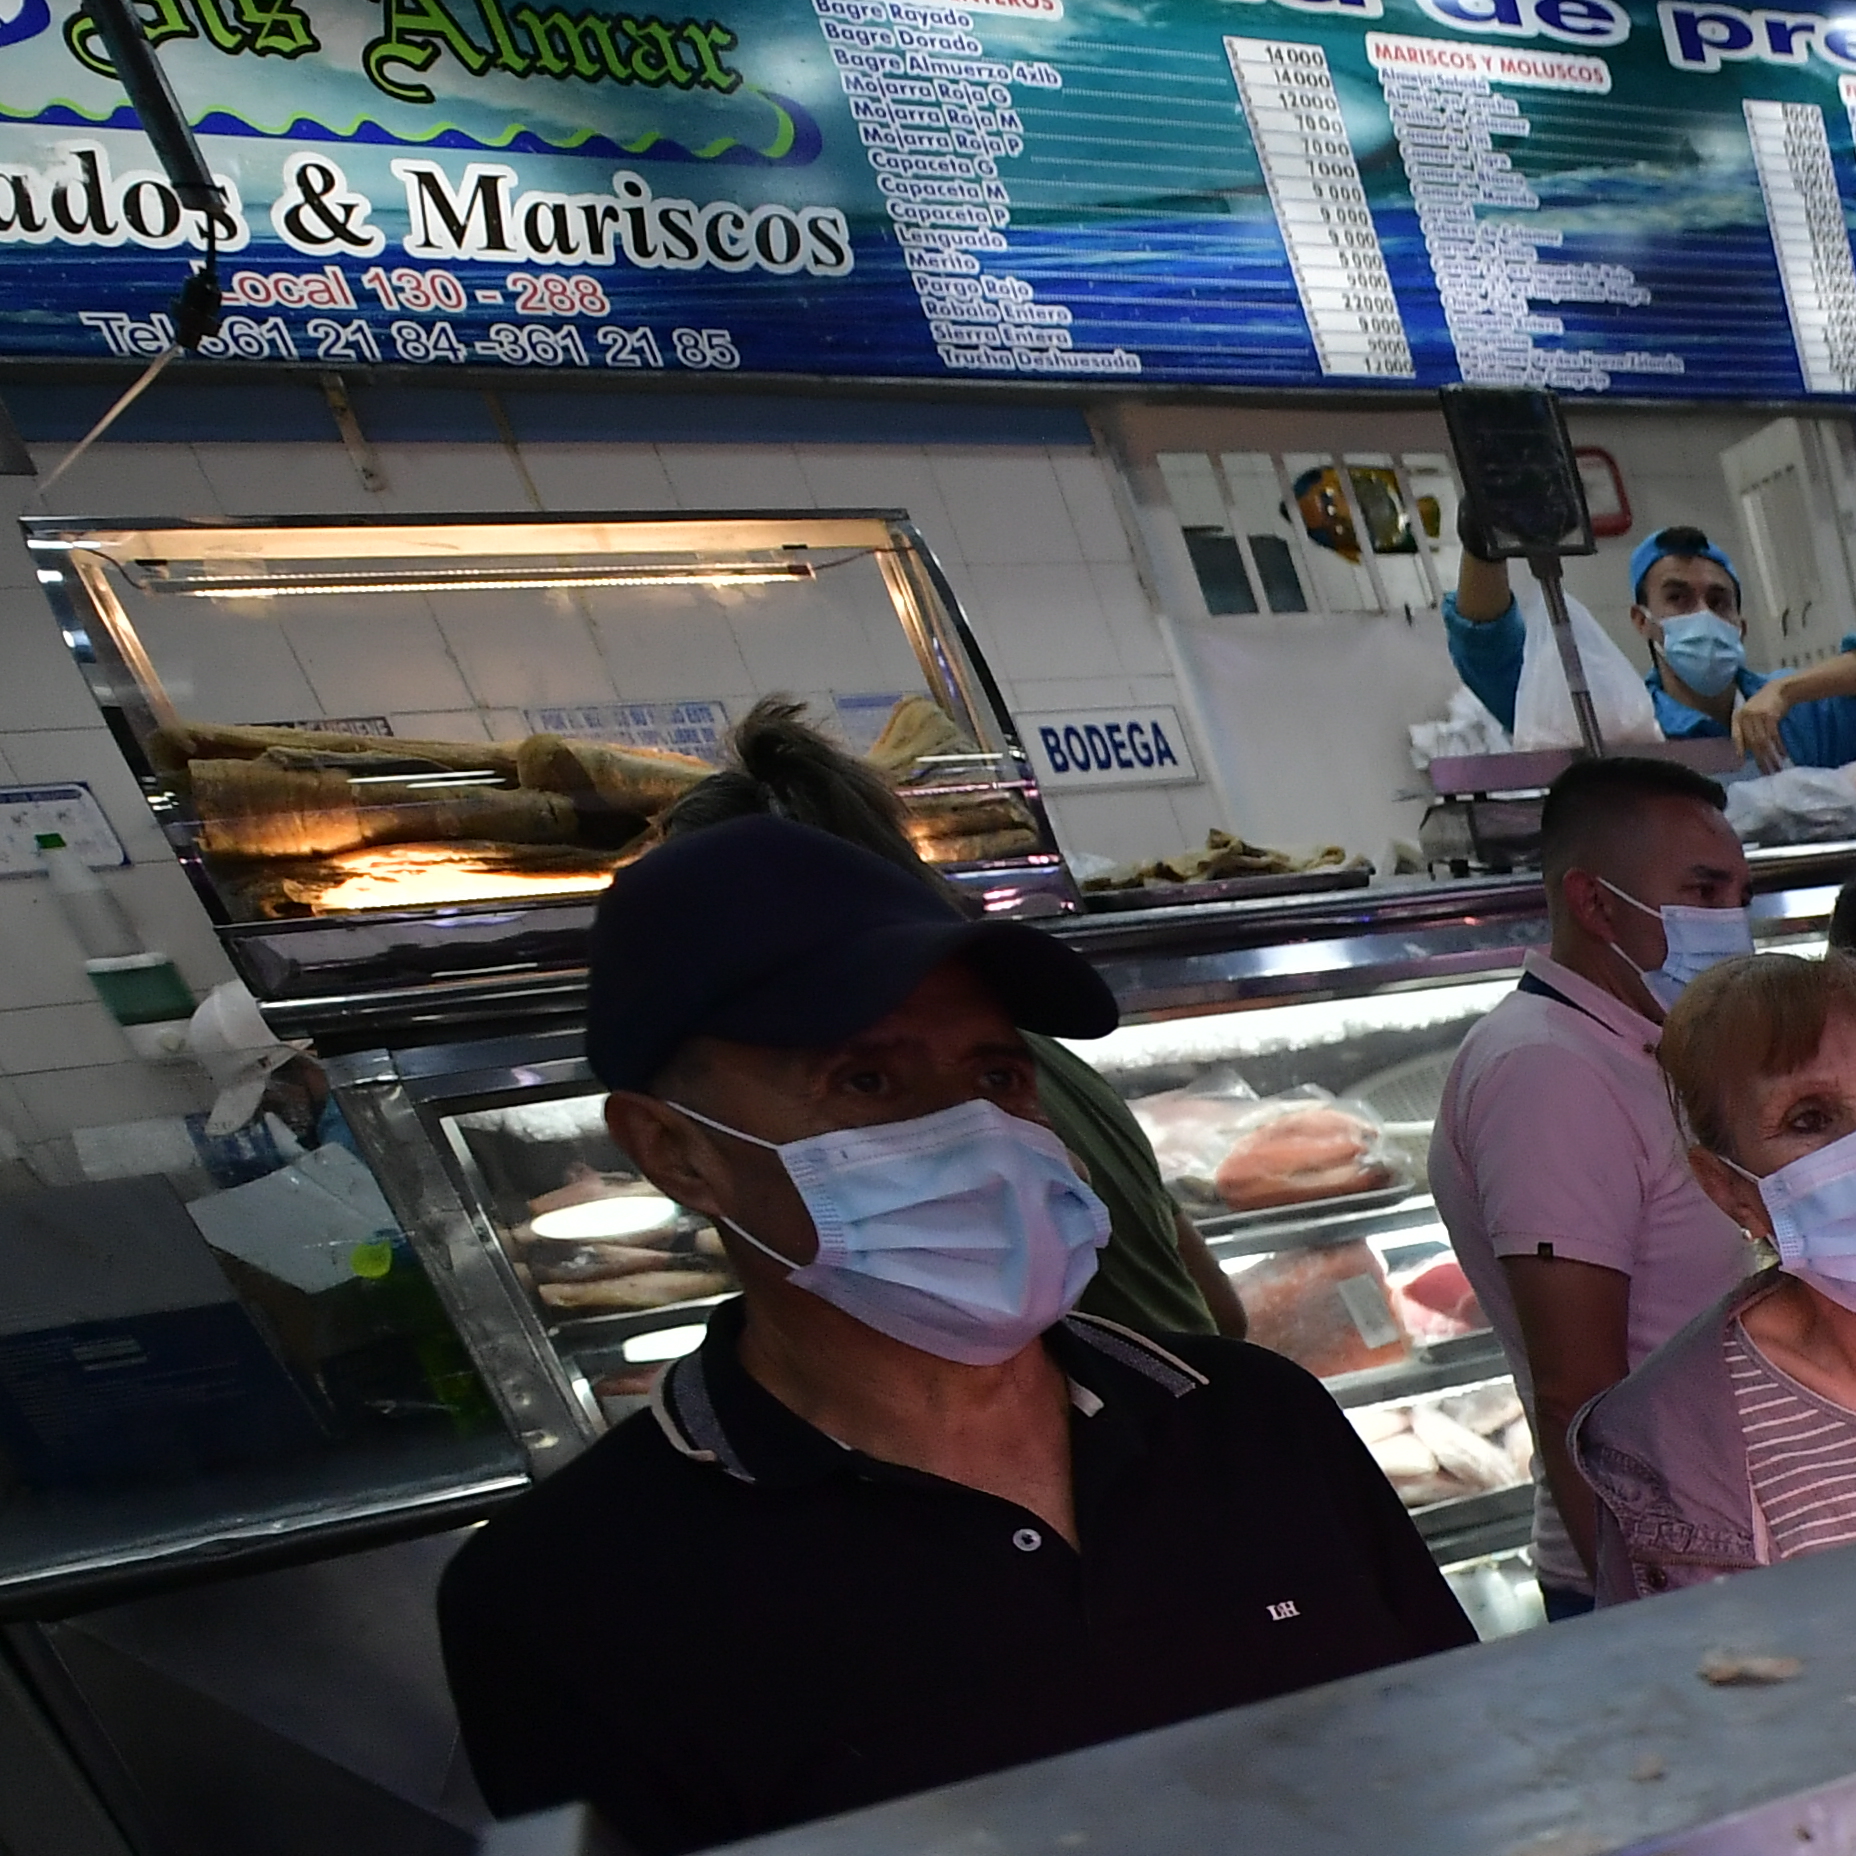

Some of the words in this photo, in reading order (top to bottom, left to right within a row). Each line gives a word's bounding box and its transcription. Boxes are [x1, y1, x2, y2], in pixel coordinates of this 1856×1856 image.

[817, 0, 884, 19] Bagre
[890, 2, 971, 28] Rayado
[824, 21, 893, 46] Bagre
[899, 28, 980, 53] Dorado
[834, 47, 902, 72] Bagre
[909, 55, 1009, 81] Almuerzo
[1373, 42, 1477, 71] MARISCOS
[1499, 57, 1604, 84] MOLUSCOS
[845, 74, 932, 98] Mojarra
[938, 81, 985, 104] Roja
[853, 100, 941, 124] Mojarra
[949, 107, 994, 131] Roja
[998, 112, 1021, 131] M
[862, 126, 950, 151] Mojarra
[954, 132, 1002, 155] Roja
[1005, 137, 1022, 155] P
[872, 151, 972, 174] Capaceta
[881, 176, 980, 199] Capaceta
[985, 183, 1007, 200] M
[283, 162, 375, 247] &
[403, 169, 846, 268] Mariscos
[890, 201, 988, 224] Capaceta
[994, 208, 1008, 225] P
[899, 225, 1005, 250] Lenguado
[363, 267, 466, 311] 130
[508, 274, 609, 317] 288
[916, 274, 980, 299] Pargo
[985, 276, 1030, 301] Rojo
[925, 298, 999, 320] Robalo
[1003, 301, 1069, 324] Entero
[306, 320, 380, 362] 21
[391, 320, 465, 364] 84
[598, 326, 664, 367] 21
[672, 328, 741, 368] 85
[932, 322, 999, 342] Sierra
[939, 347, 1012, 368] Trucha
[1037, 720, 1179, 773] BODEGA
